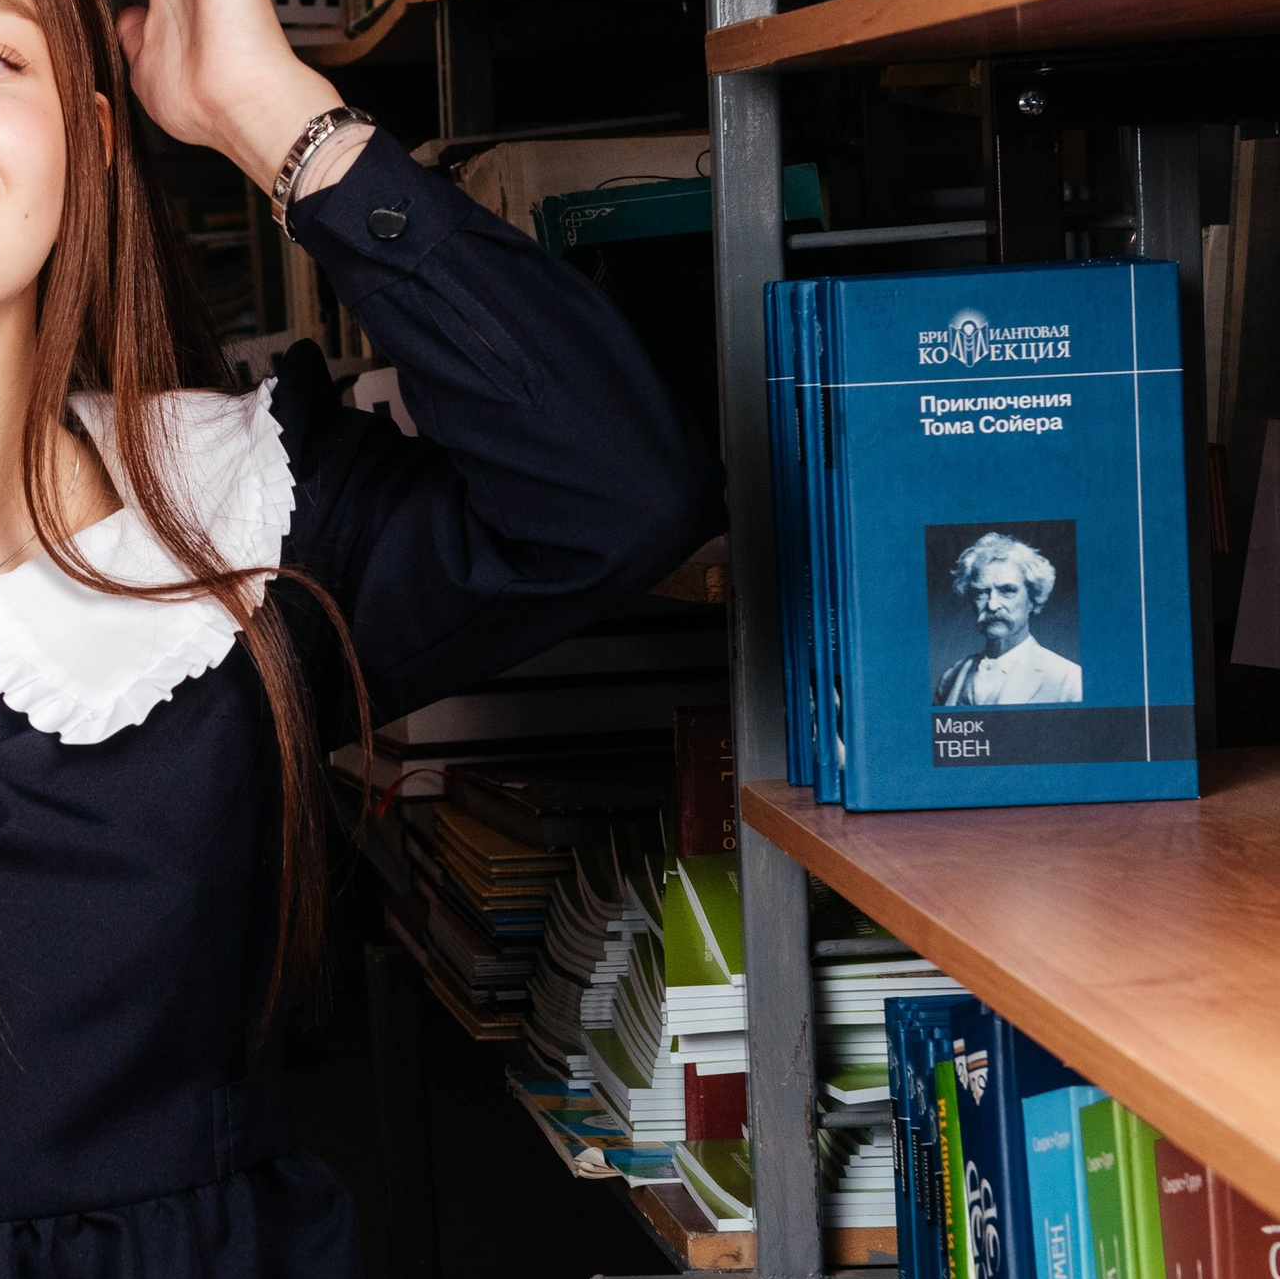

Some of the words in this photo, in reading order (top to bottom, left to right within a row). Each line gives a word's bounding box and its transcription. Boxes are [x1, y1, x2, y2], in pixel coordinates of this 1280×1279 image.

[920, 393, 1072, 416] Приключения
[920, 418, 974, 436] Тома
[978, 415, 1063, 435] Сойера
[935, 718, 984, 737] Марк
[935, 739, 990, 758] ТВЕН
